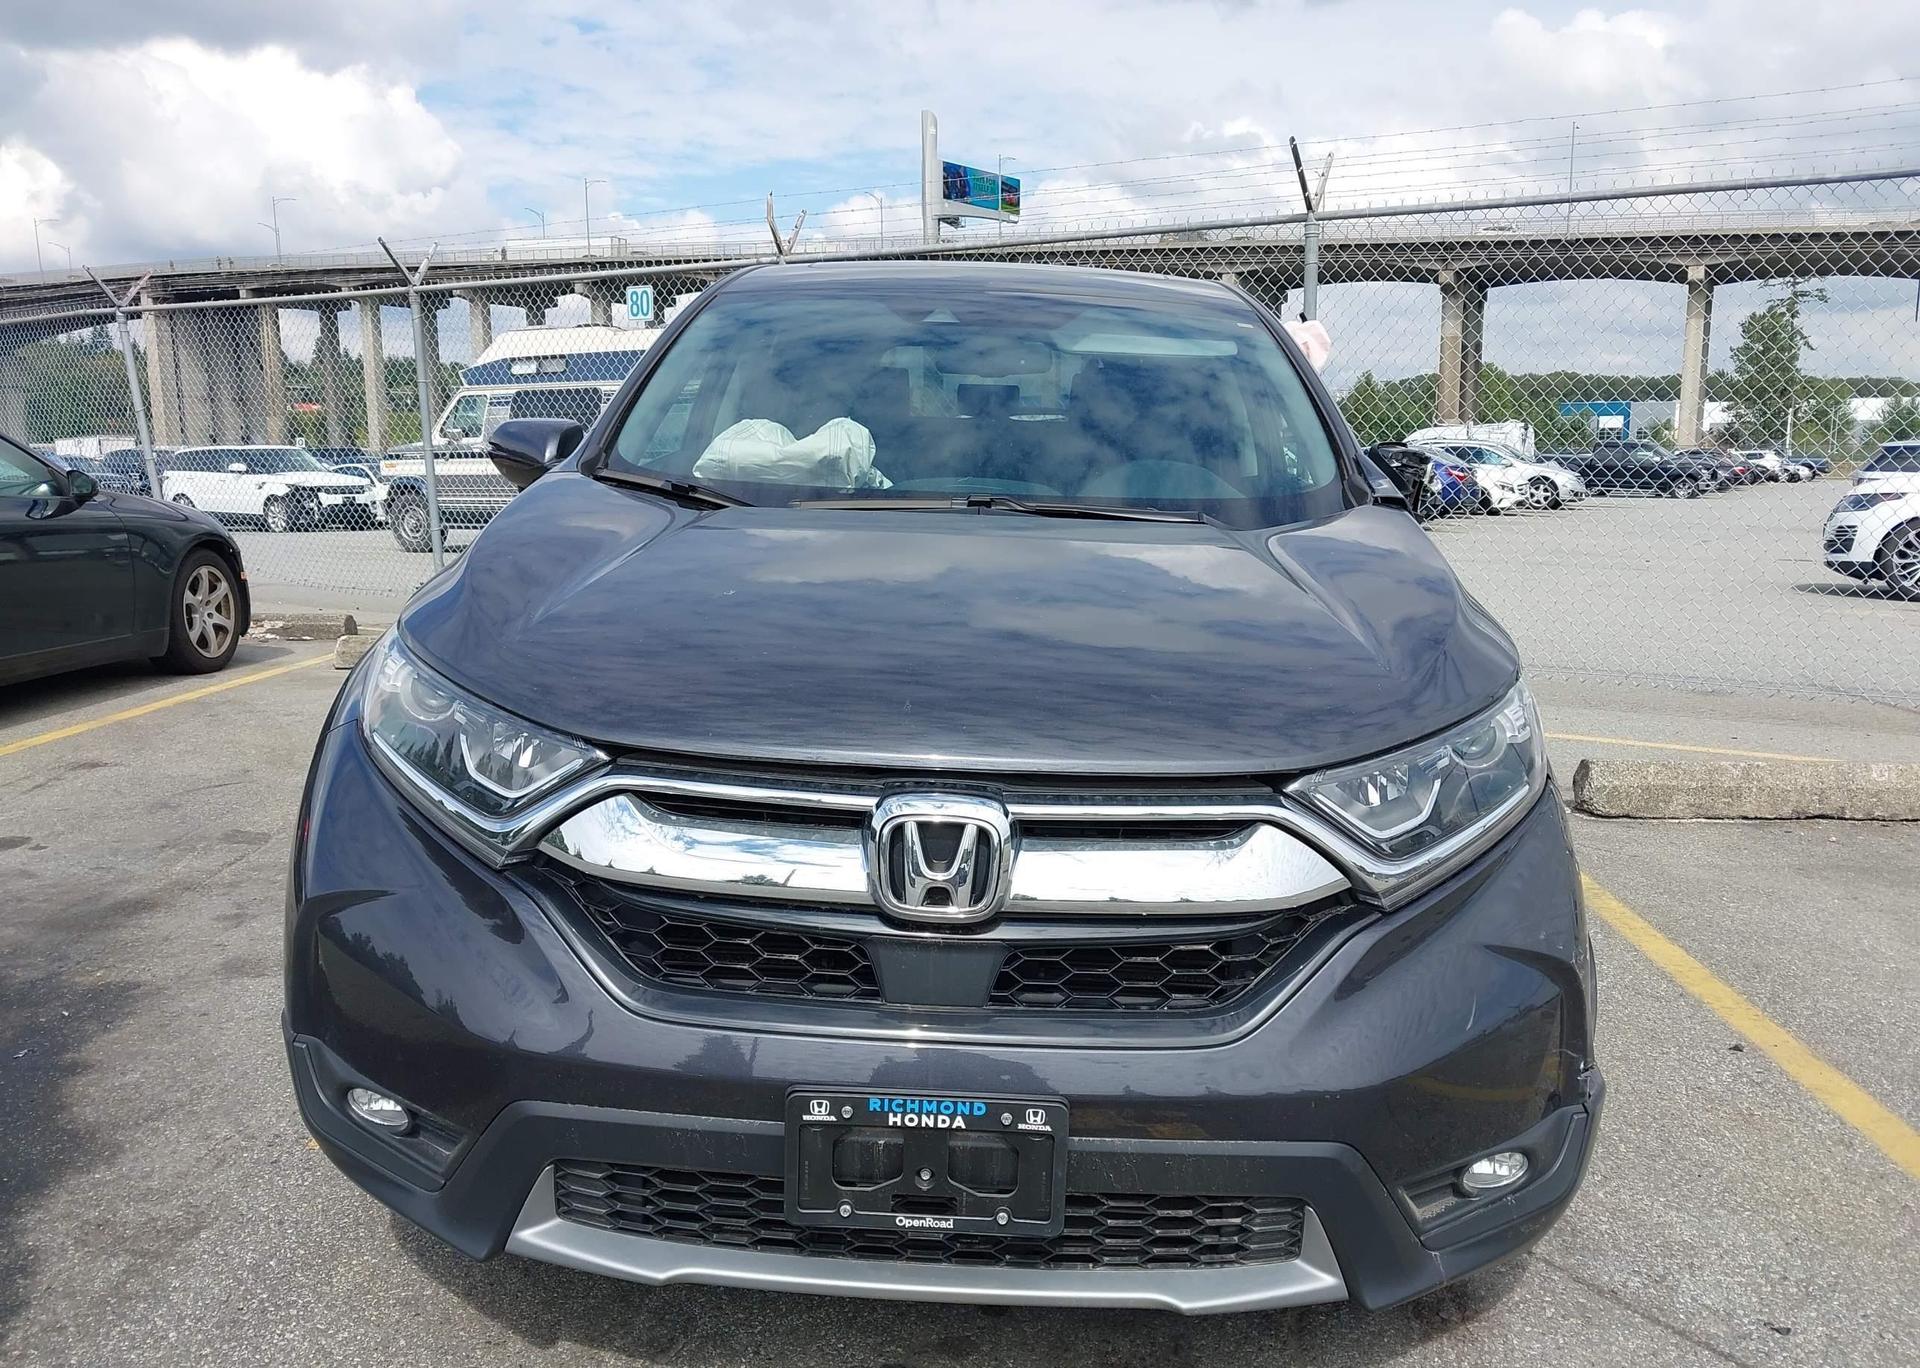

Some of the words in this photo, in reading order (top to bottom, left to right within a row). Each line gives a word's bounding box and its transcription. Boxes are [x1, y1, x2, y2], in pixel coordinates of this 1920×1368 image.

[630, 290, 650, 317] 80
[868, 1097, 987, 1116] RICHMOND
[888, 1112, 967, 1129] HONDA
[1017, 1123, 1053, 1132] HONDA
[895, 1216, 954, 1229] OpenRoad
